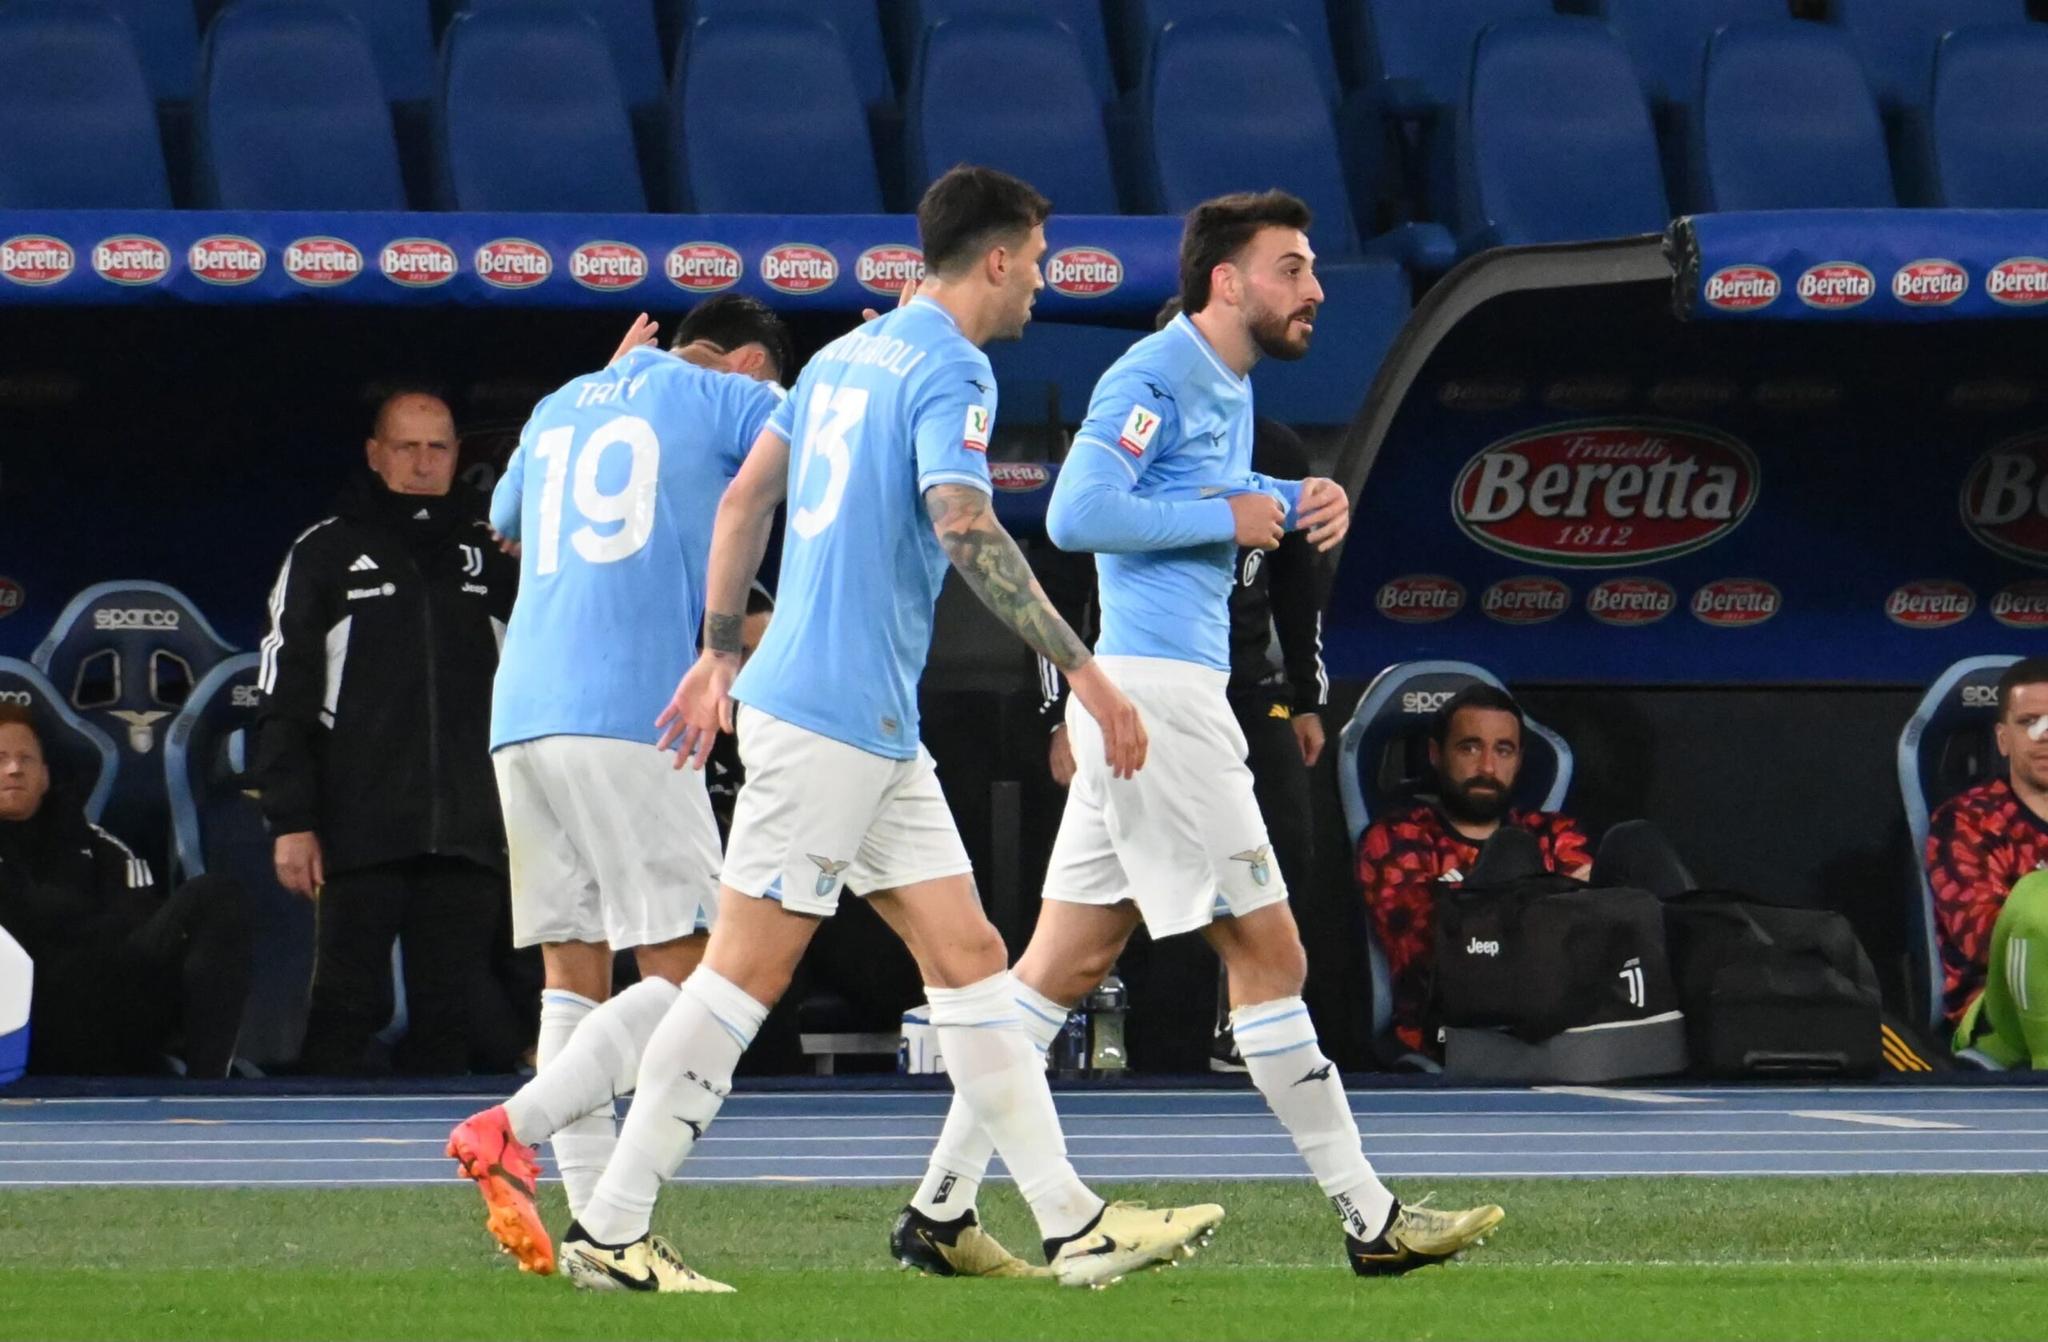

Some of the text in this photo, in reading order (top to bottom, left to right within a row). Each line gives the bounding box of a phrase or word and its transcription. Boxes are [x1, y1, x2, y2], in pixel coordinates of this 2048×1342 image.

[2, 247, 70, 271] Beretta
[97, 247, 165, 271] Beretta
[192, 247, 260, 271] Beretta
[288, 248, 357, 273] Beretta
[384, 249, 453, 274] Beretta
[479, 250, 547, 275] Beretta
[574, 252, 642, 277] Beretta
[670, 253, 737, 278] Beretta
[764, 255, 833, 280] Beretta
[1050, 259, 1118, 284] Beretta
[1709, 277, 1776, 300] Beretta
[1802, 275, 1869, 297] Beretta
[1896, 273, 1963, 295] Beretta
[1564, 436, 1669, 459] Fratelli
[792, 383, 868, 540] 13
[990, 466, 1045, 481] eretta
[534, 415, 660, 575] 19
[1465, 452, 1738, 522] Beretta
[1554, 525, 1634, 546] 1812
[1379, 586, 1460, 609] Beretta
[1485, 589, 1565, 611] Beretta
[1591, 589, 1670, 612] Beretta
[1697, 591, 1776, 613] Beretta
[1890, 592, 1969, 614] Beretta
[1994, 592, 2048, 615] Bere
[94, 608, 179, 630] sparco
[1467, 937, 1499, 957] Jeep
